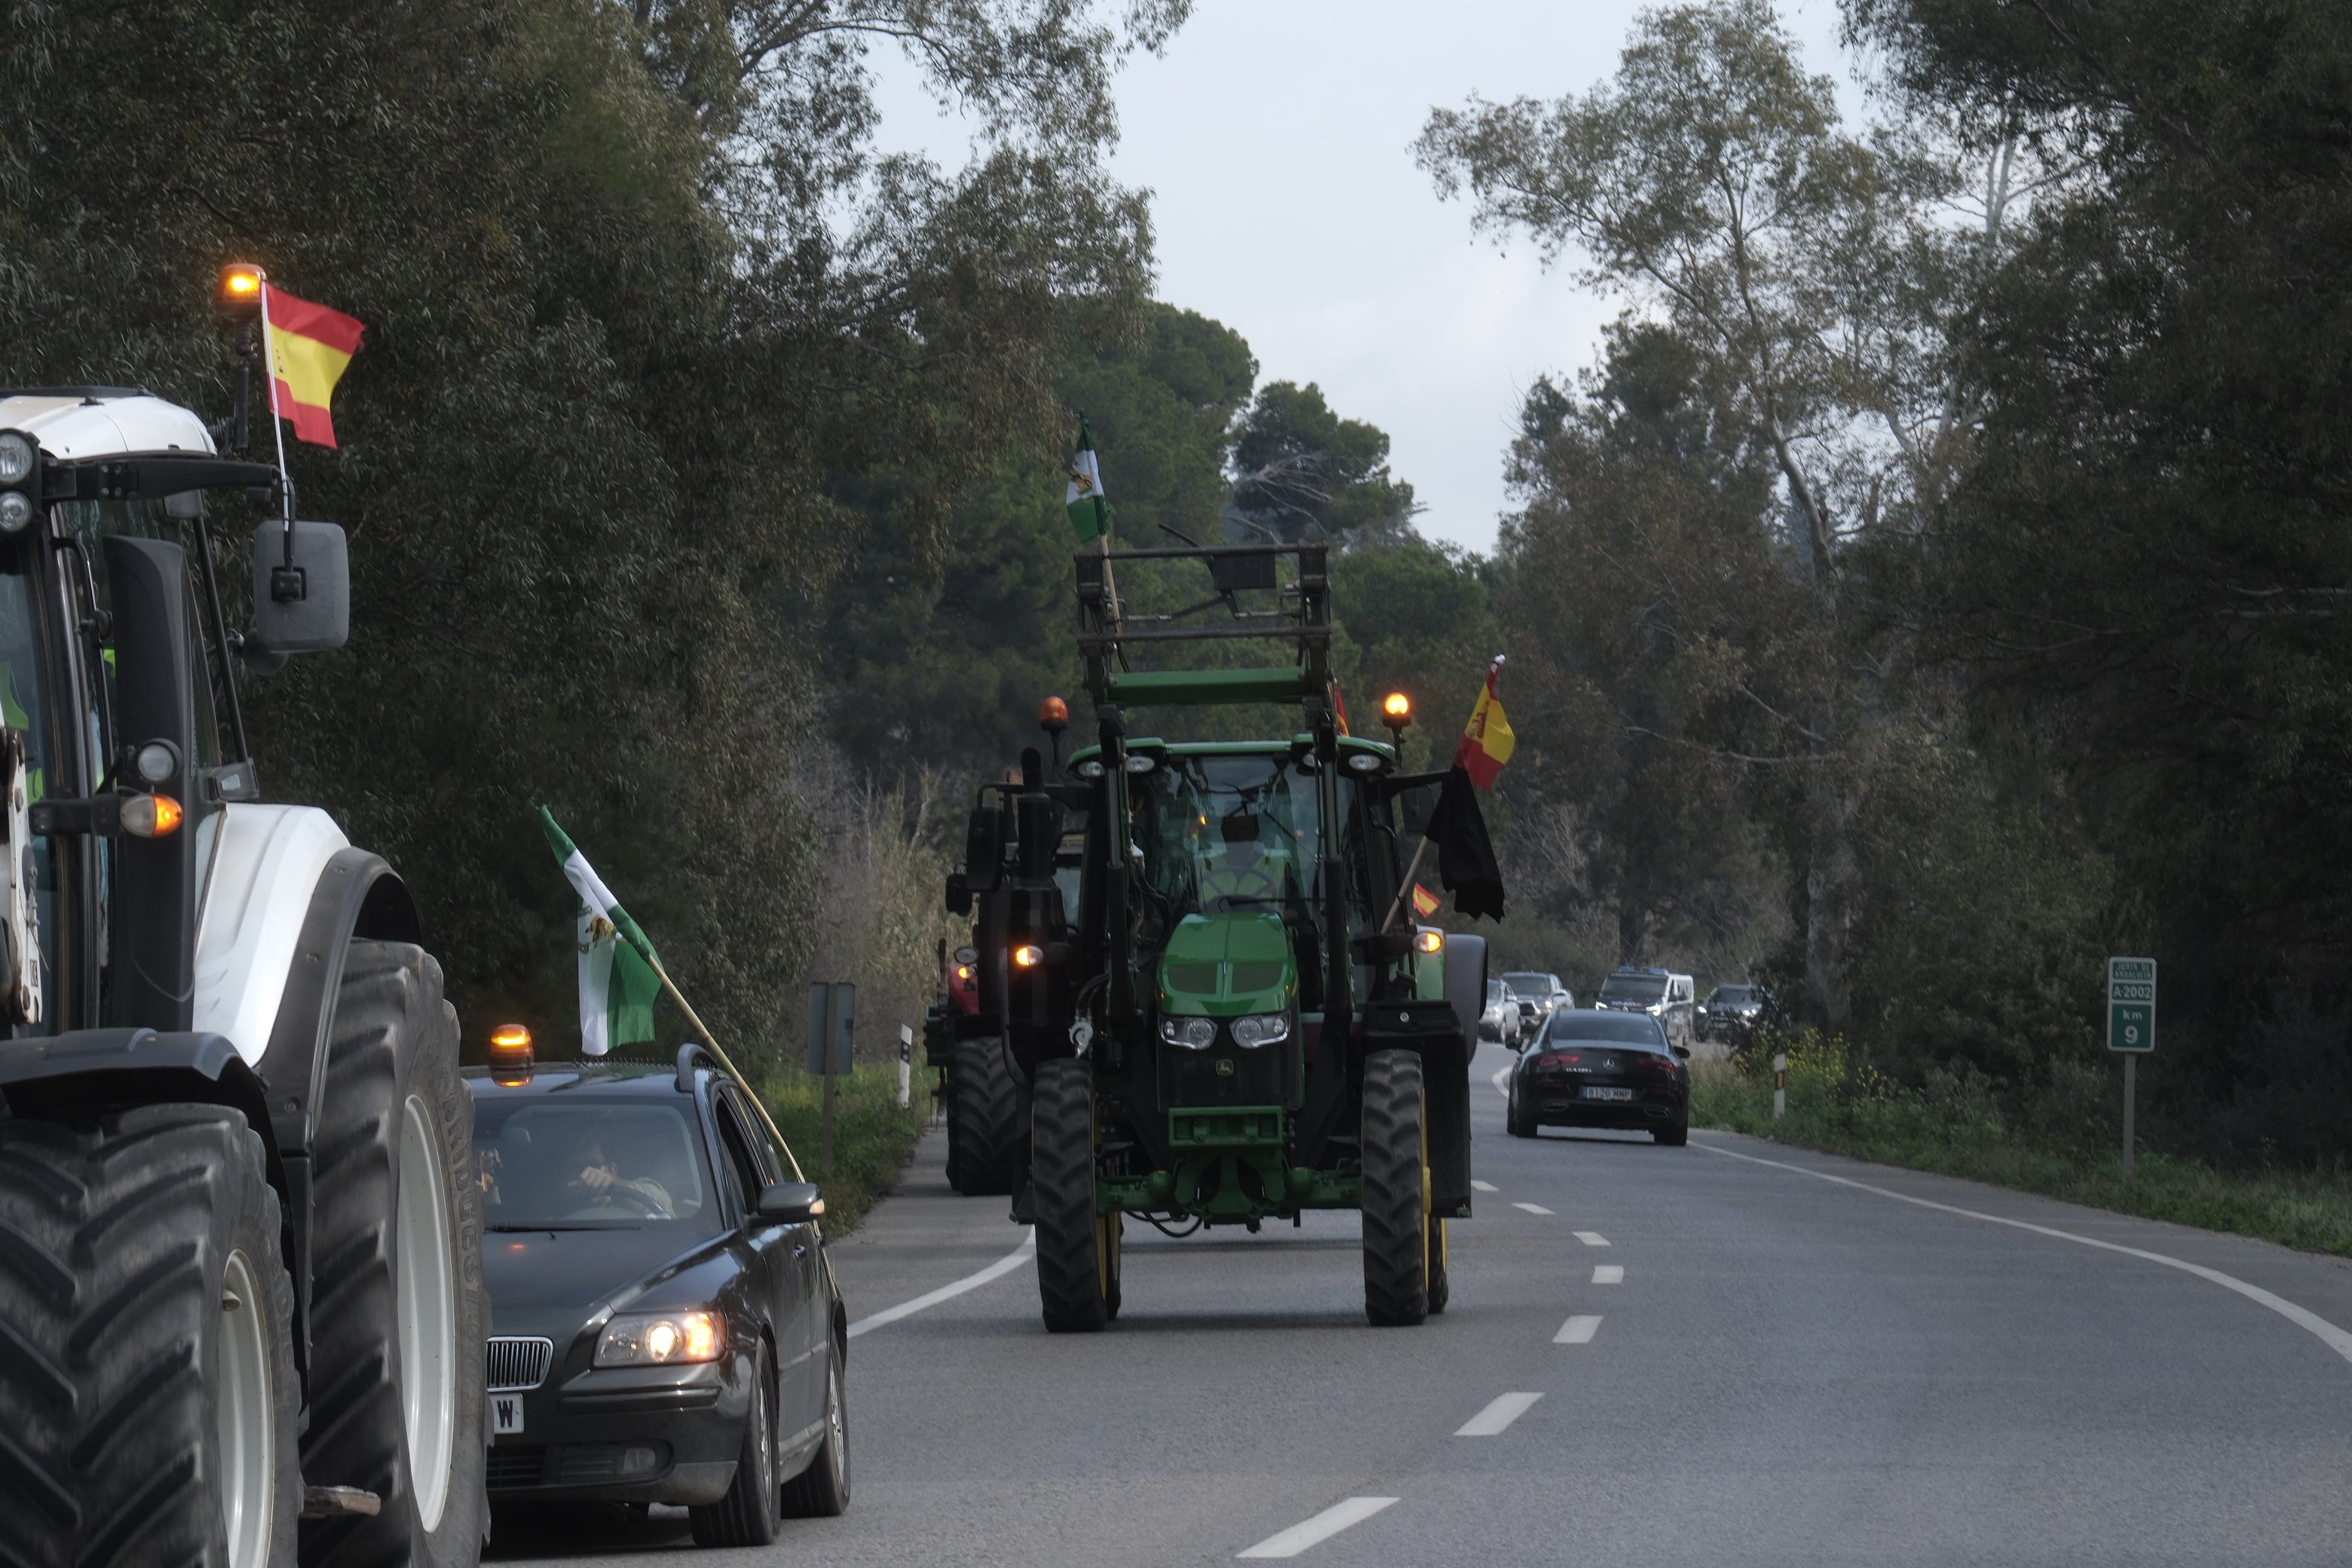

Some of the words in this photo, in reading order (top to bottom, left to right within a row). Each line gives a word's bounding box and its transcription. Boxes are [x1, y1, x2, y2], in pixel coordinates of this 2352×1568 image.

[2116, 962, 2138, 970] JUNTA
[2113, 985, 2151, 999] A-2002
[2123, 1009, 2142, 1020] km
[2124, 1024, 2139, 1045] 9
[496, 1399, 513, 1429] W
